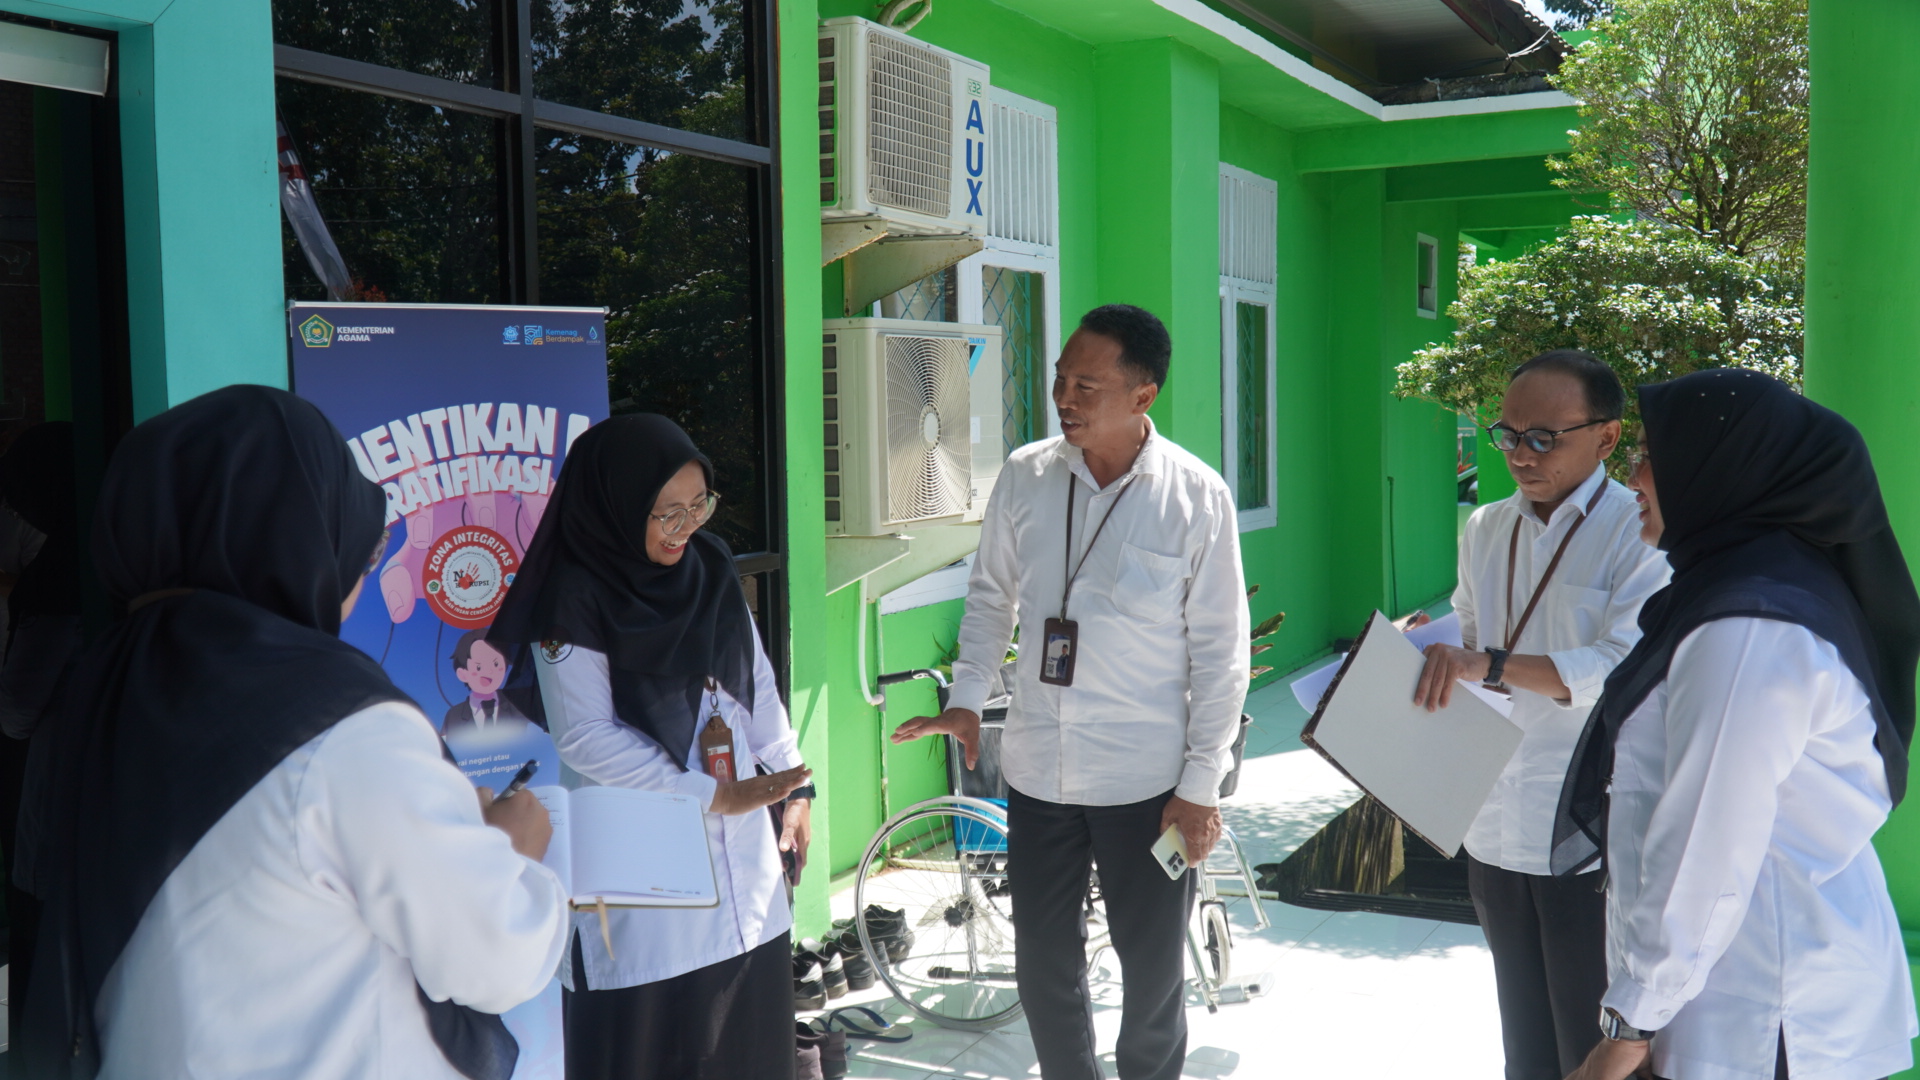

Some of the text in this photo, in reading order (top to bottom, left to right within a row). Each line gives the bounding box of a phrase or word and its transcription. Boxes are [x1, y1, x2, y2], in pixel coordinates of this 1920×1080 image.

[968, 81, 981, 94] R32
[965, 99, 984, 217] AUX
[336, 326, 394, 334] KEMENTERIAN
[545, 328, 578, 337] Kemenag
[545, 336, 584, 344] Berdampak
[384, 455, 552, 527] RATIFIKASI
[429, 532, 513, 573] ZONA INTEGRITAS
[455, 580, 489, 588] KRUPSI
[444, 592, 505, 616] MAN INSAN CENDEKIA JAMBI
[468, 756, 492, 766] negeri
[493, 753, 510, 761] atau
[491, 764, 519, 775] dengan
